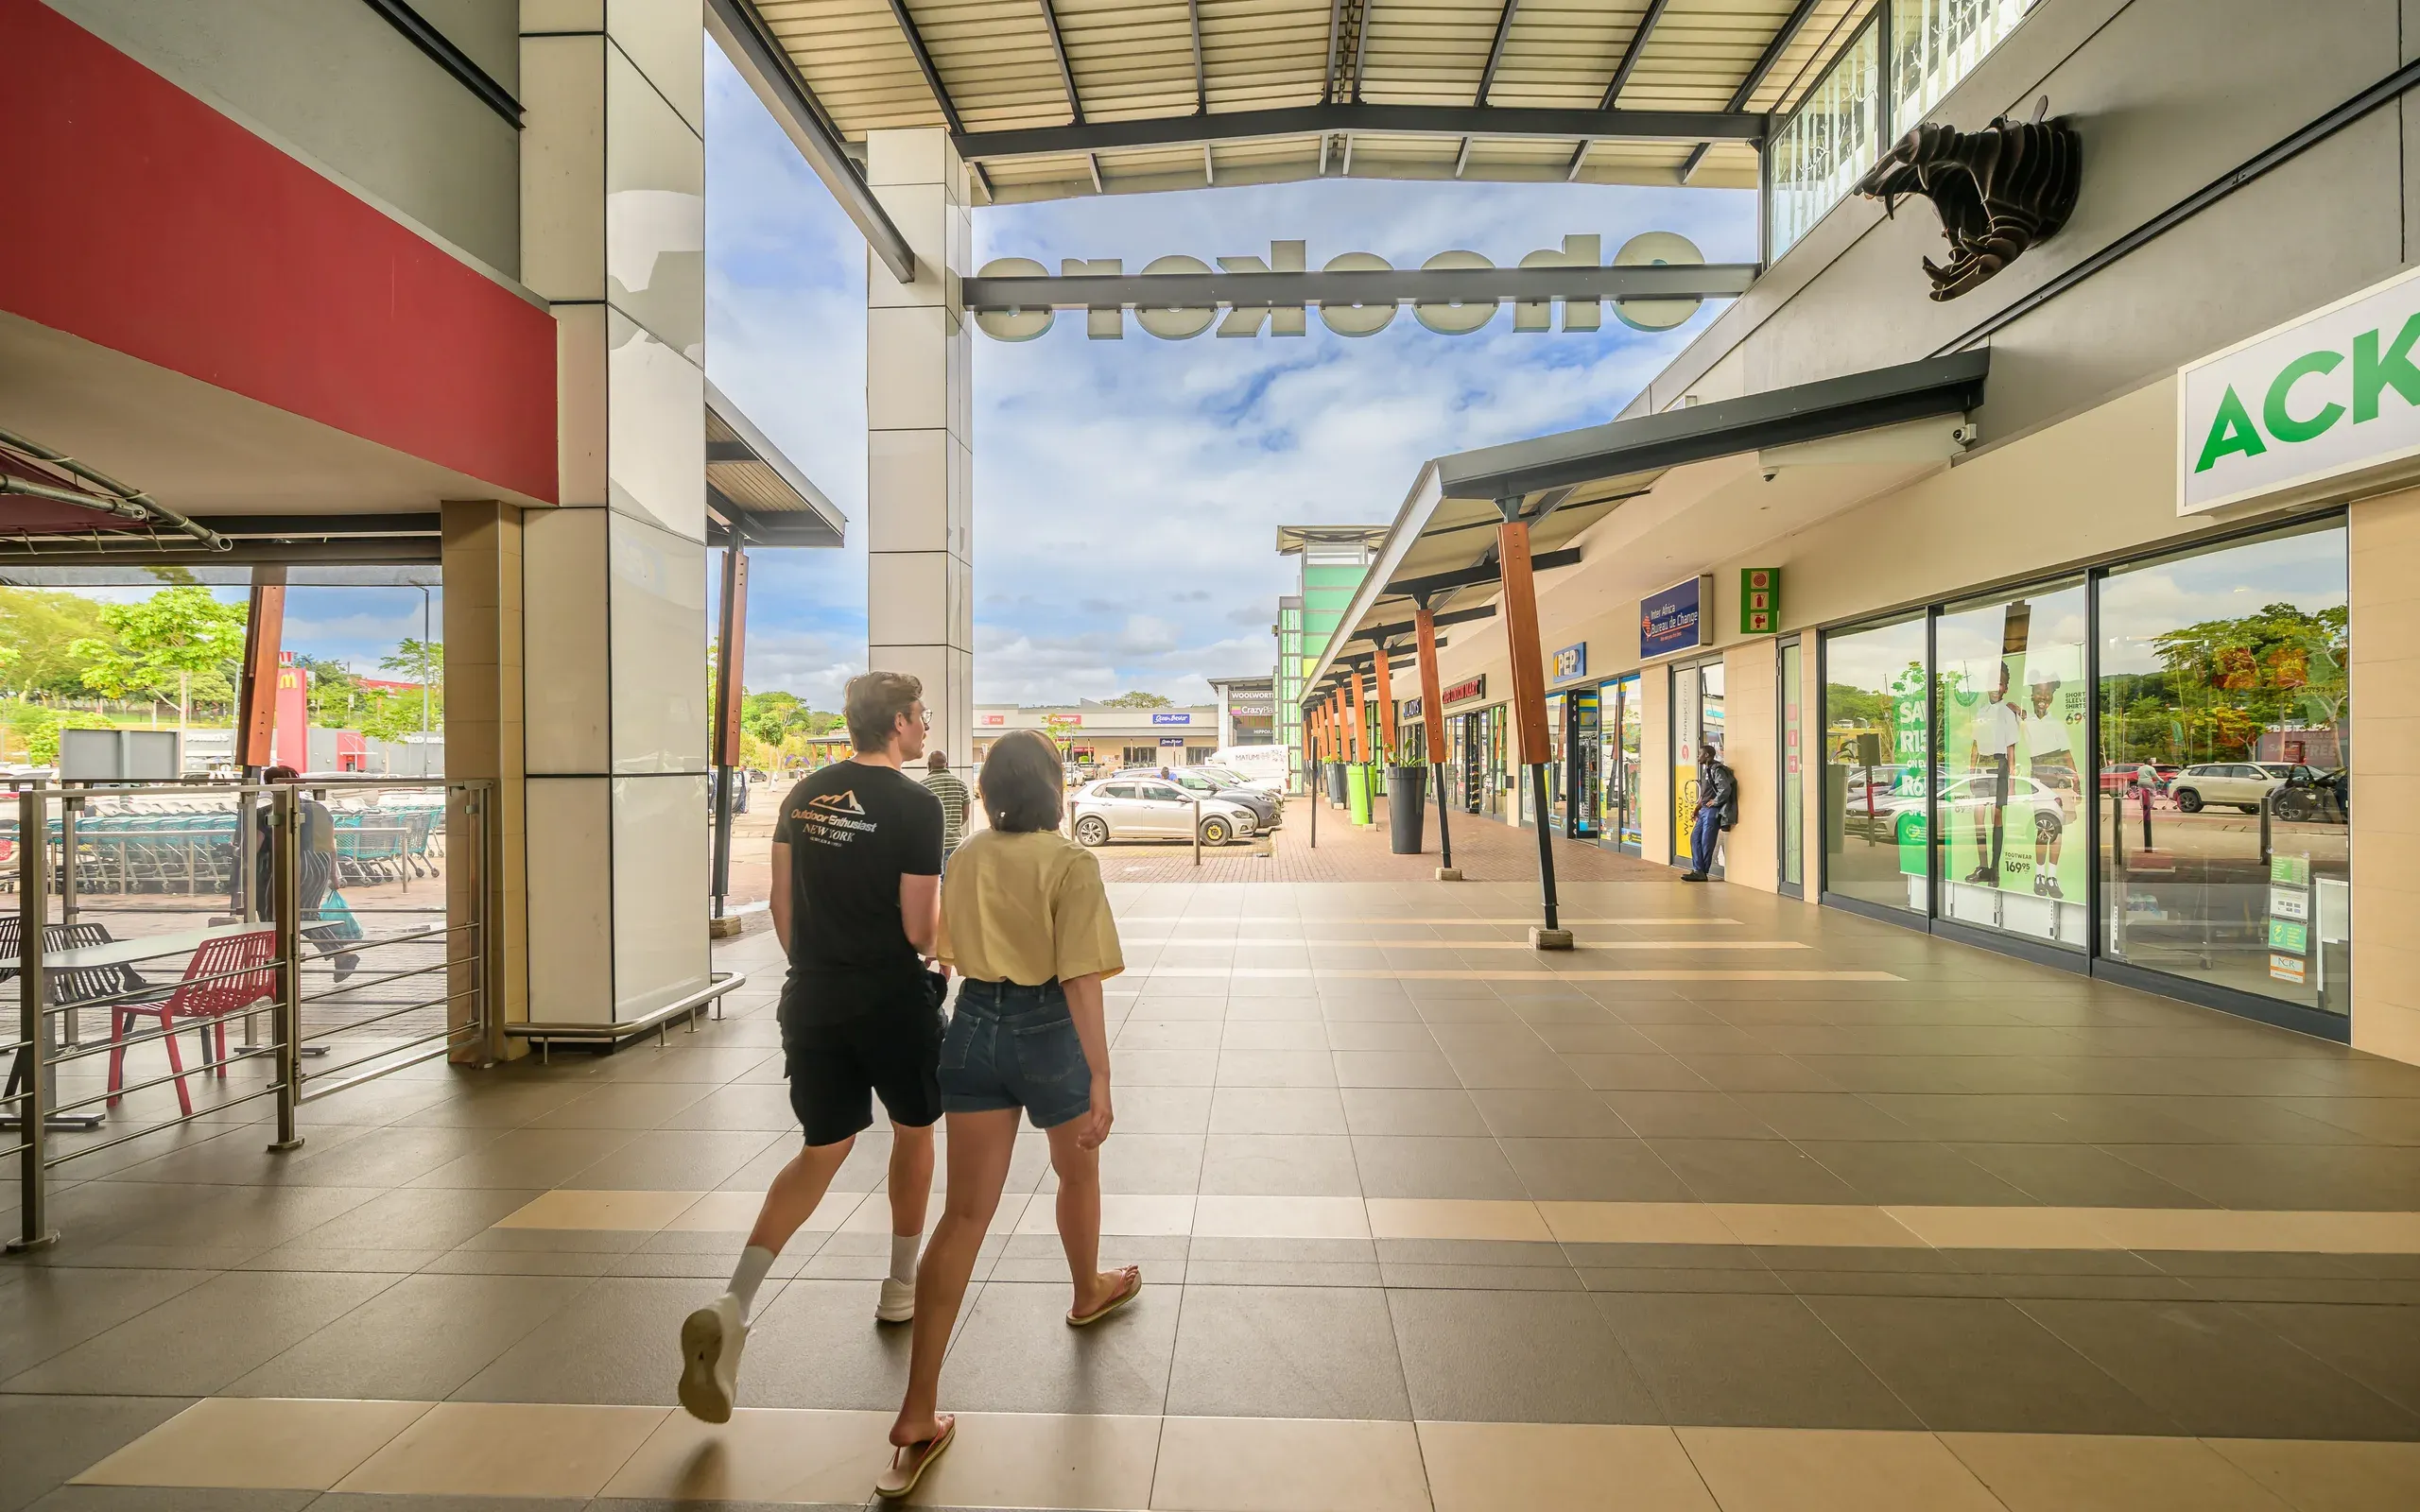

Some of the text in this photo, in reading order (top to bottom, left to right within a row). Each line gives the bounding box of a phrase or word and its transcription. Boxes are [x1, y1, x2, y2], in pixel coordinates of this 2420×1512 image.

[2193, 312, 2420, 473] ACK
[1651, 603, 1676, 620] Inter Africa
[1651, 611, 1699, 635] Bureau de Change
[1558, 649, 1576, 677] PEP
[791, 809, 877, 833] Outdoor Enthusiast
[803, 823, 829, 836] NEW
[829, 828, 856, 842] YORK
[2005, 851, 2032, 860] FOOTWEAR
[2277, 957, 2295, 969] NCR
